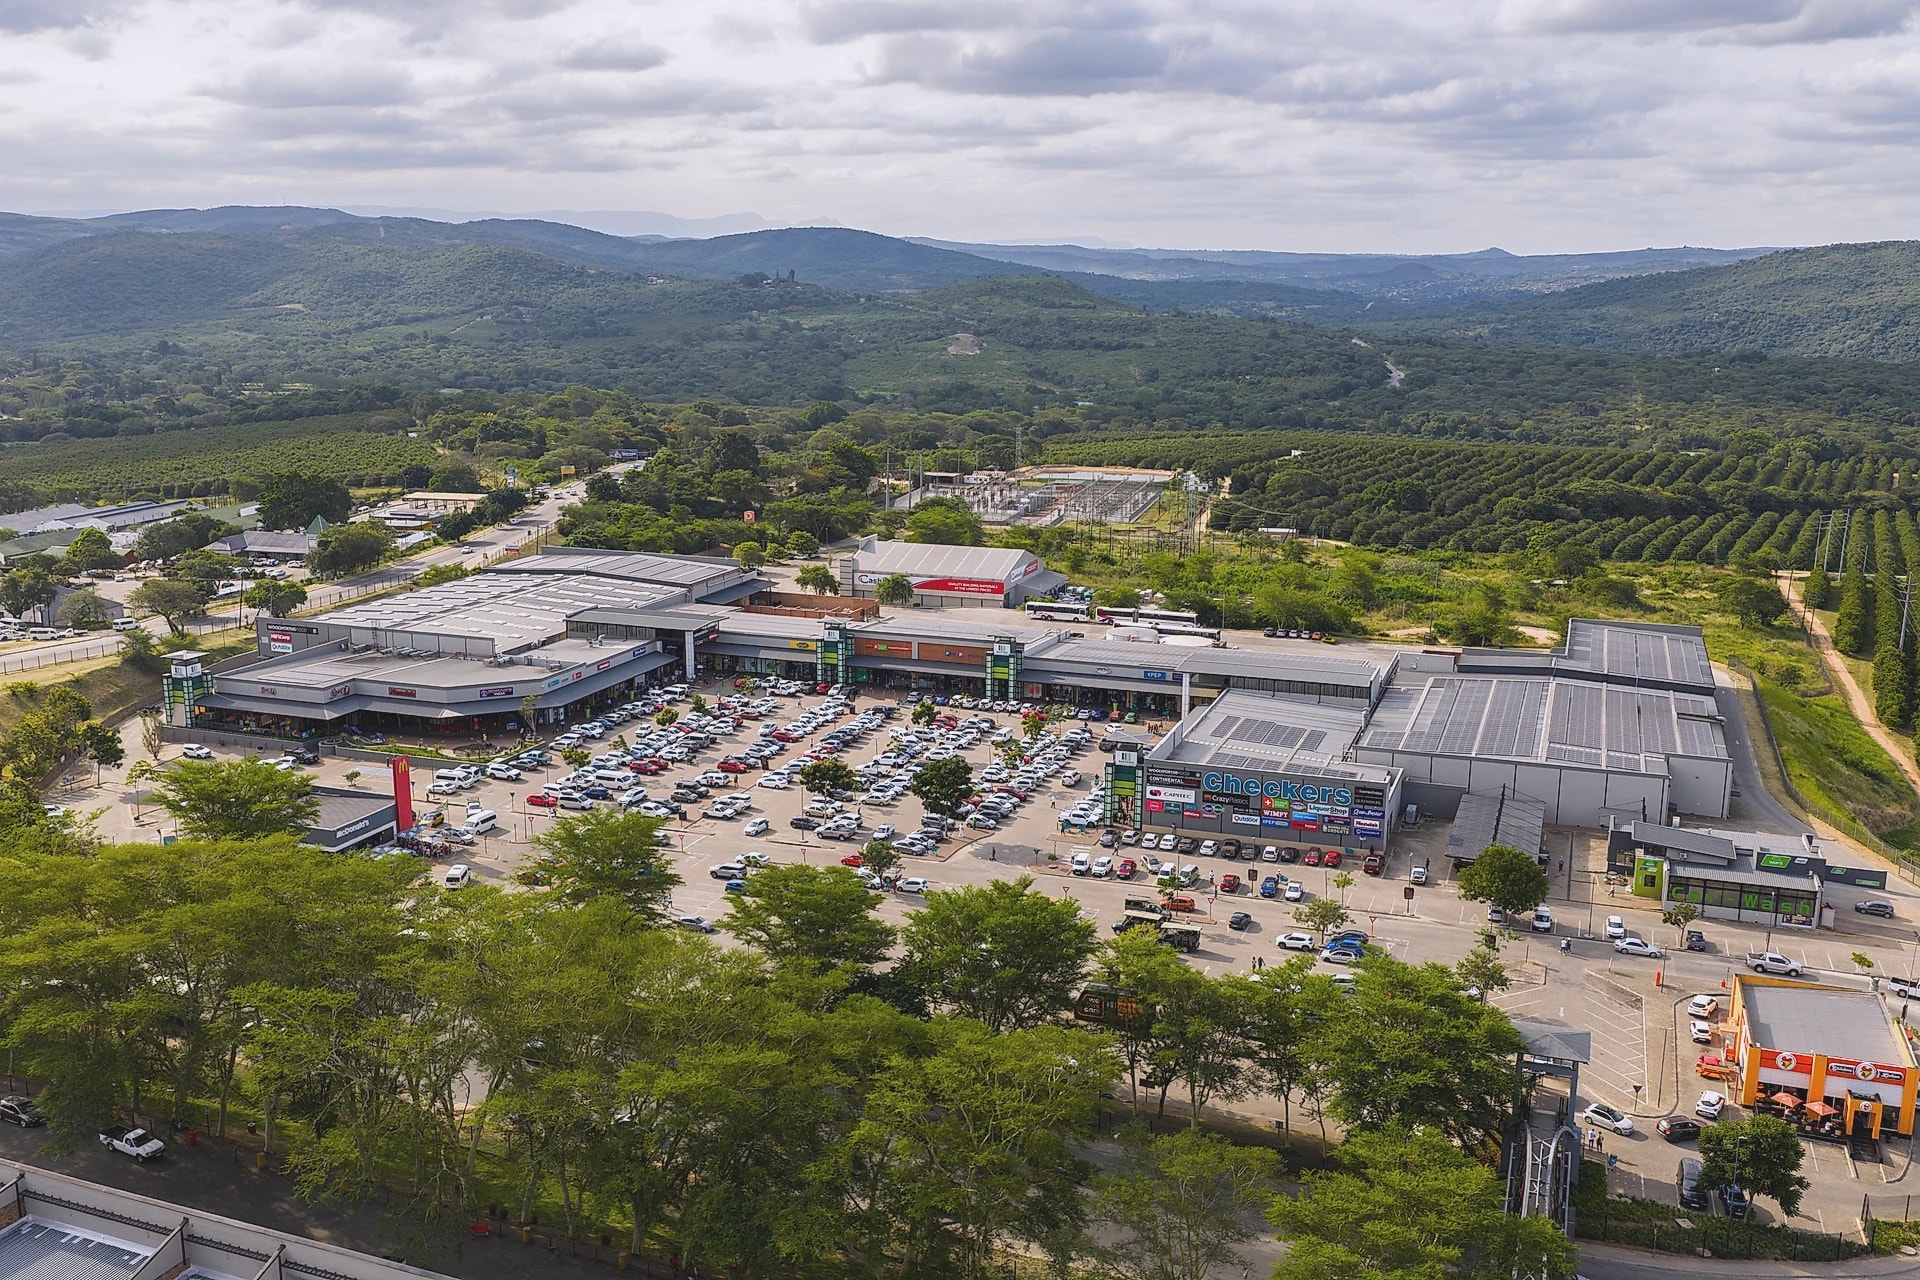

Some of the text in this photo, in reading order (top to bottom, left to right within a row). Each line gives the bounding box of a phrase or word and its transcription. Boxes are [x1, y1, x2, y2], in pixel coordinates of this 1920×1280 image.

[1149, 776, 1184, 784] CONTINENTAL
[1203, 771, 1353, 806] Checkers
[1163, 792, 1192, 800] CAPITEC
[1263, 809, 1288, 818] WIMPY
[336, 819, 370, 839] McDonald's
[1084, 1006, 1100, 1014] car
